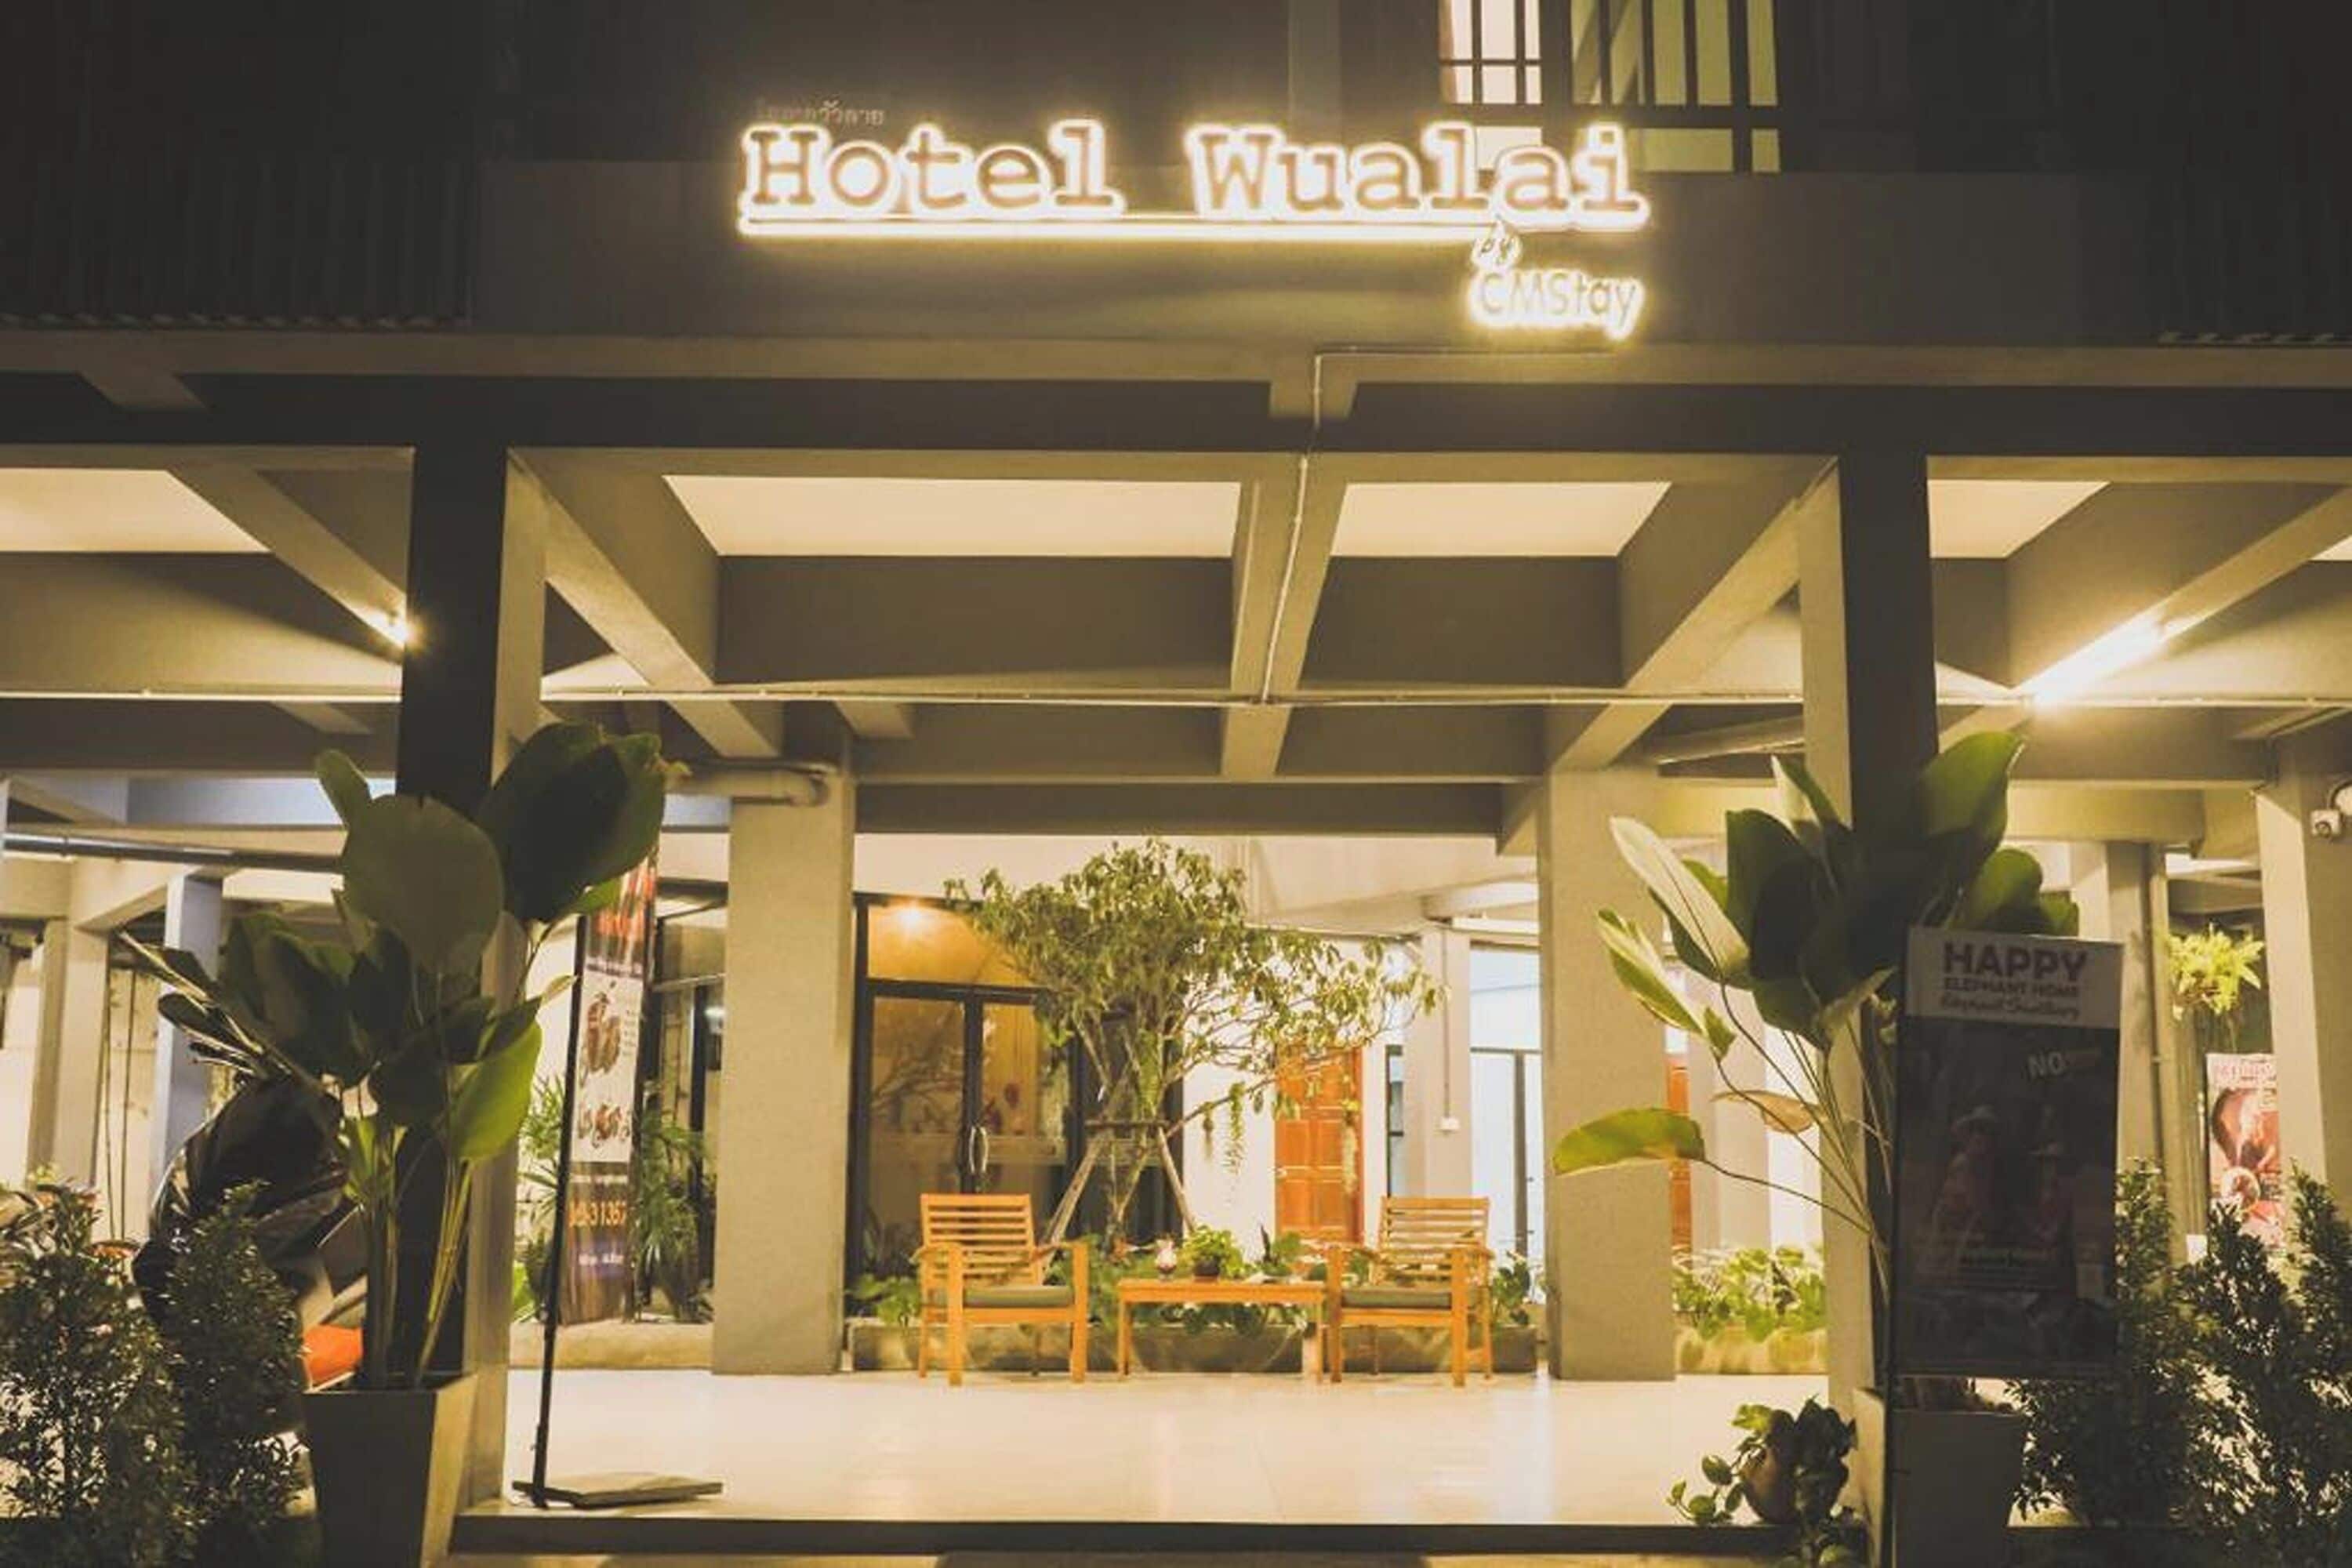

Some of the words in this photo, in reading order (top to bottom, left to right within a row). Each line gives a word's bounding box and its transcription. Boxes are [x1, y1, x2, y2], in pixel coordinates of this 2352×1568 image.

[747, 123, 1117, 212] Hotel
[1194, 123, 1644, 214] Wualai
[1481, 270, 1637, 328] CMStay
[1944, 942, 2088, 982] HAPPY
[2027, 1051, 2064, 1079] NO
